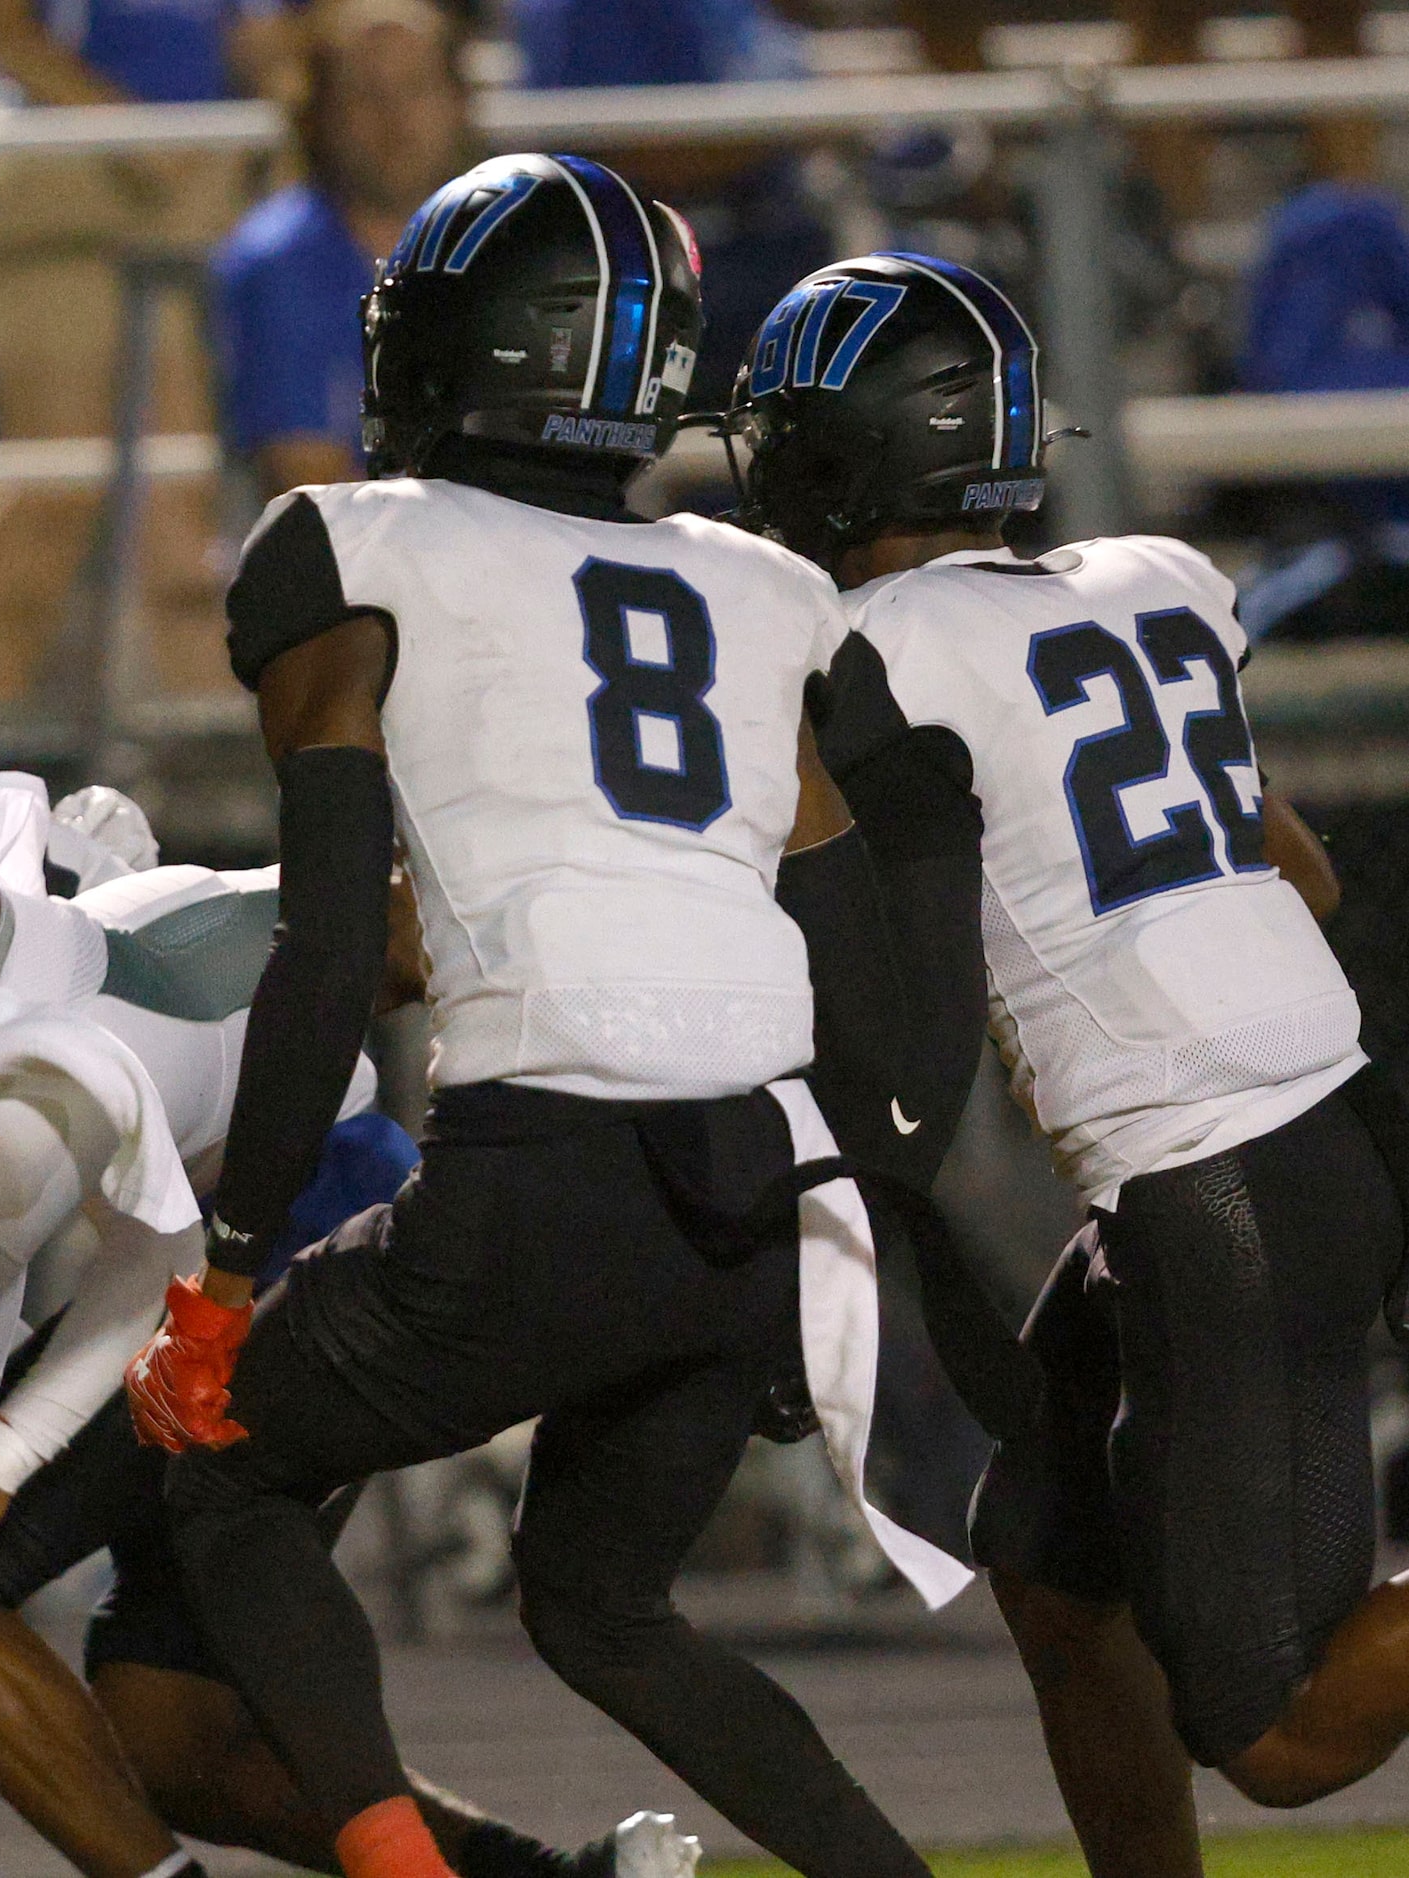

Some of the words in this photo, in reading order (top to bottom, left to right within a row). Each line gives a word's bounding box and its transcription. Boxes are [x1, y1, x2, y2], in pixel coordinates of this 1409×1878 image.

[643, 377, 662, 414] 8
[749, 276, 908, 398] 817
[543, 413, 658, 451] PANTHERS
[571, 554, 734, 834] 8
[1026, 605, 1272, 917] 22
